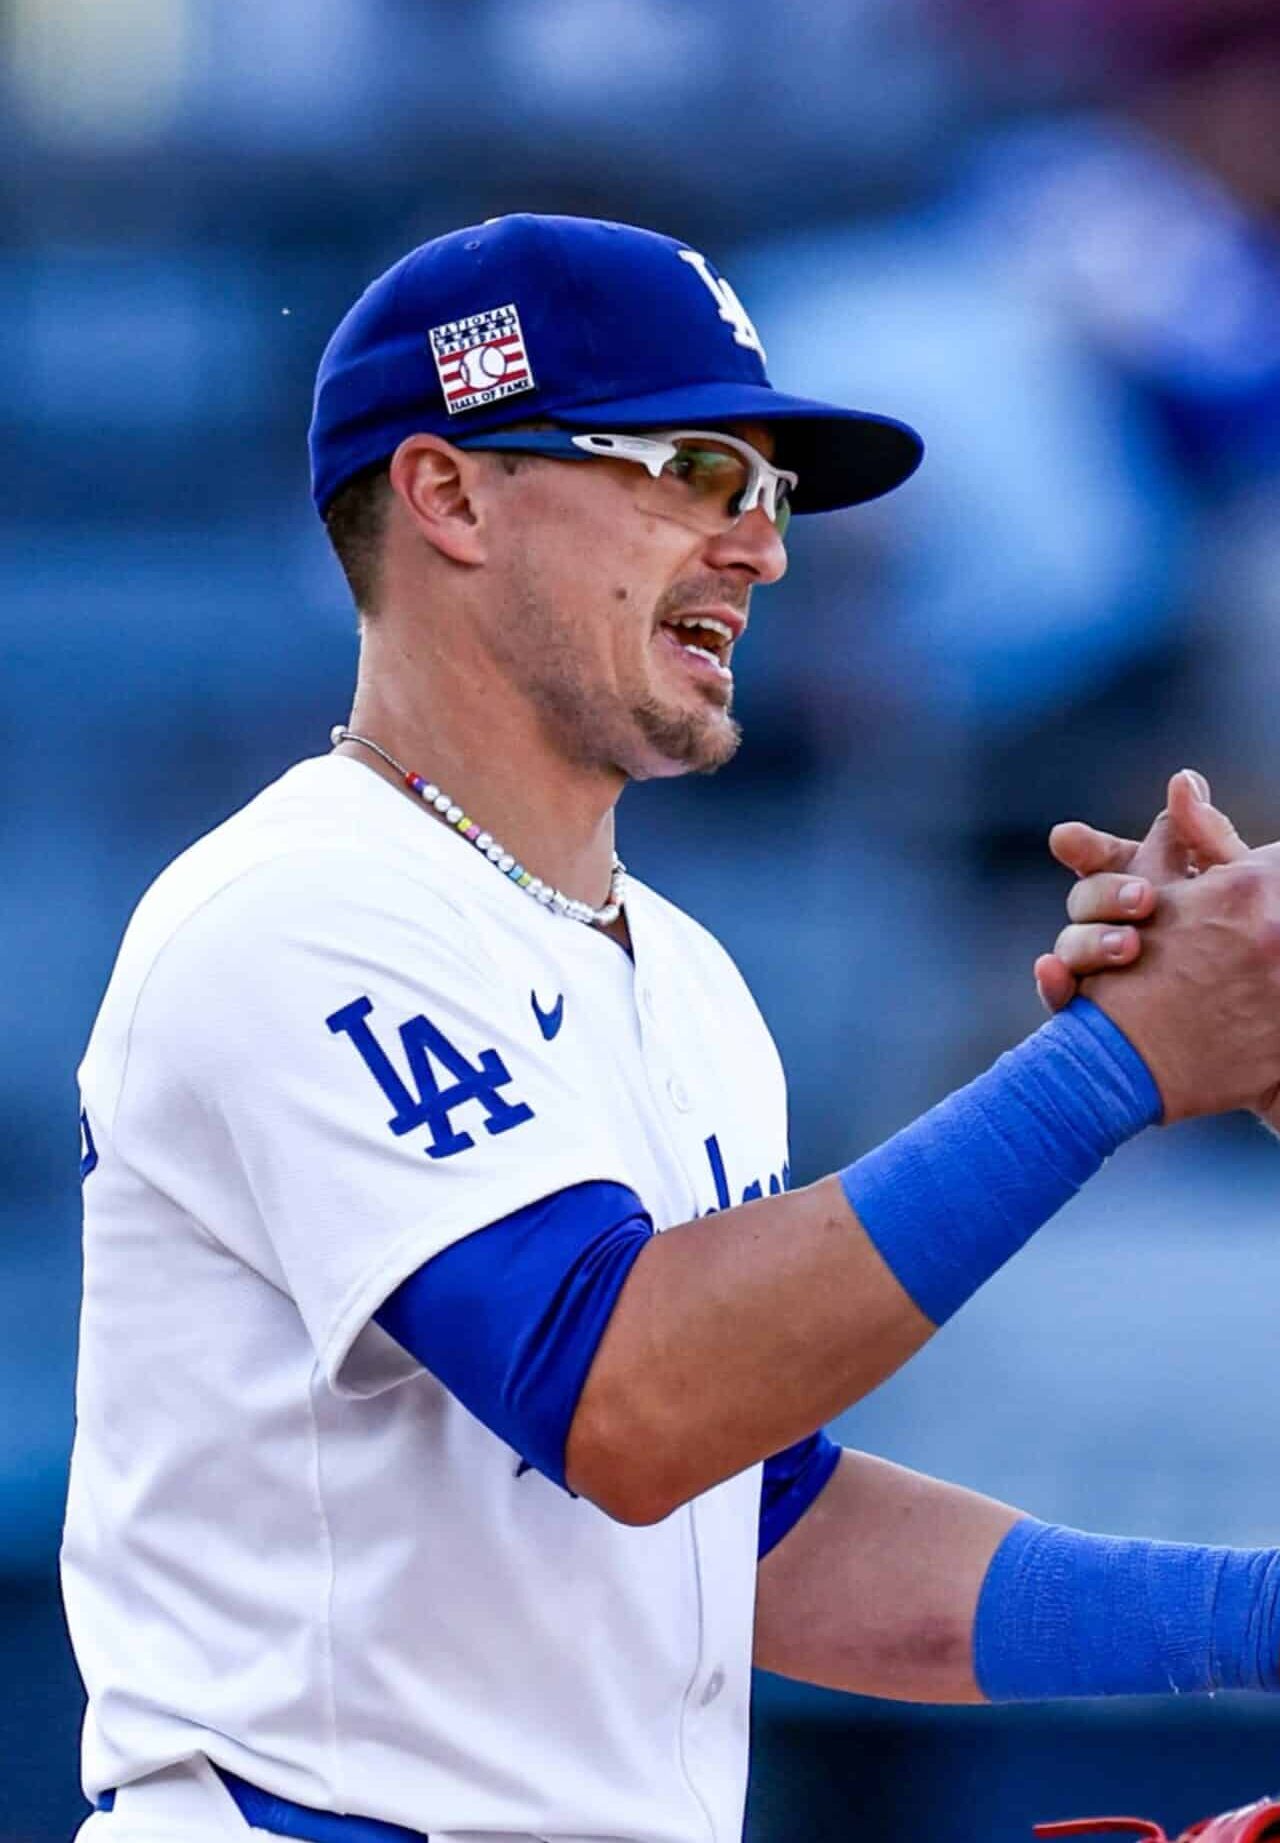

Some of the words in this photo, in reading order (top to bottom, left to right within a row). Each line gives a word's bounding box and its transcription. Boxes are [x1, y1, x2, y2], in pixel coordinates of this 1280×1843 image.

[433, 307, 514, 337] NATIONAL
[438, 326, 518, 355] BASEBALL
[450, 397, 479, 411] HALL
[481, 390, 496, 402] OF
[500, 379, 529, 395] FAME
[325, 995, 535, 1159] LA
